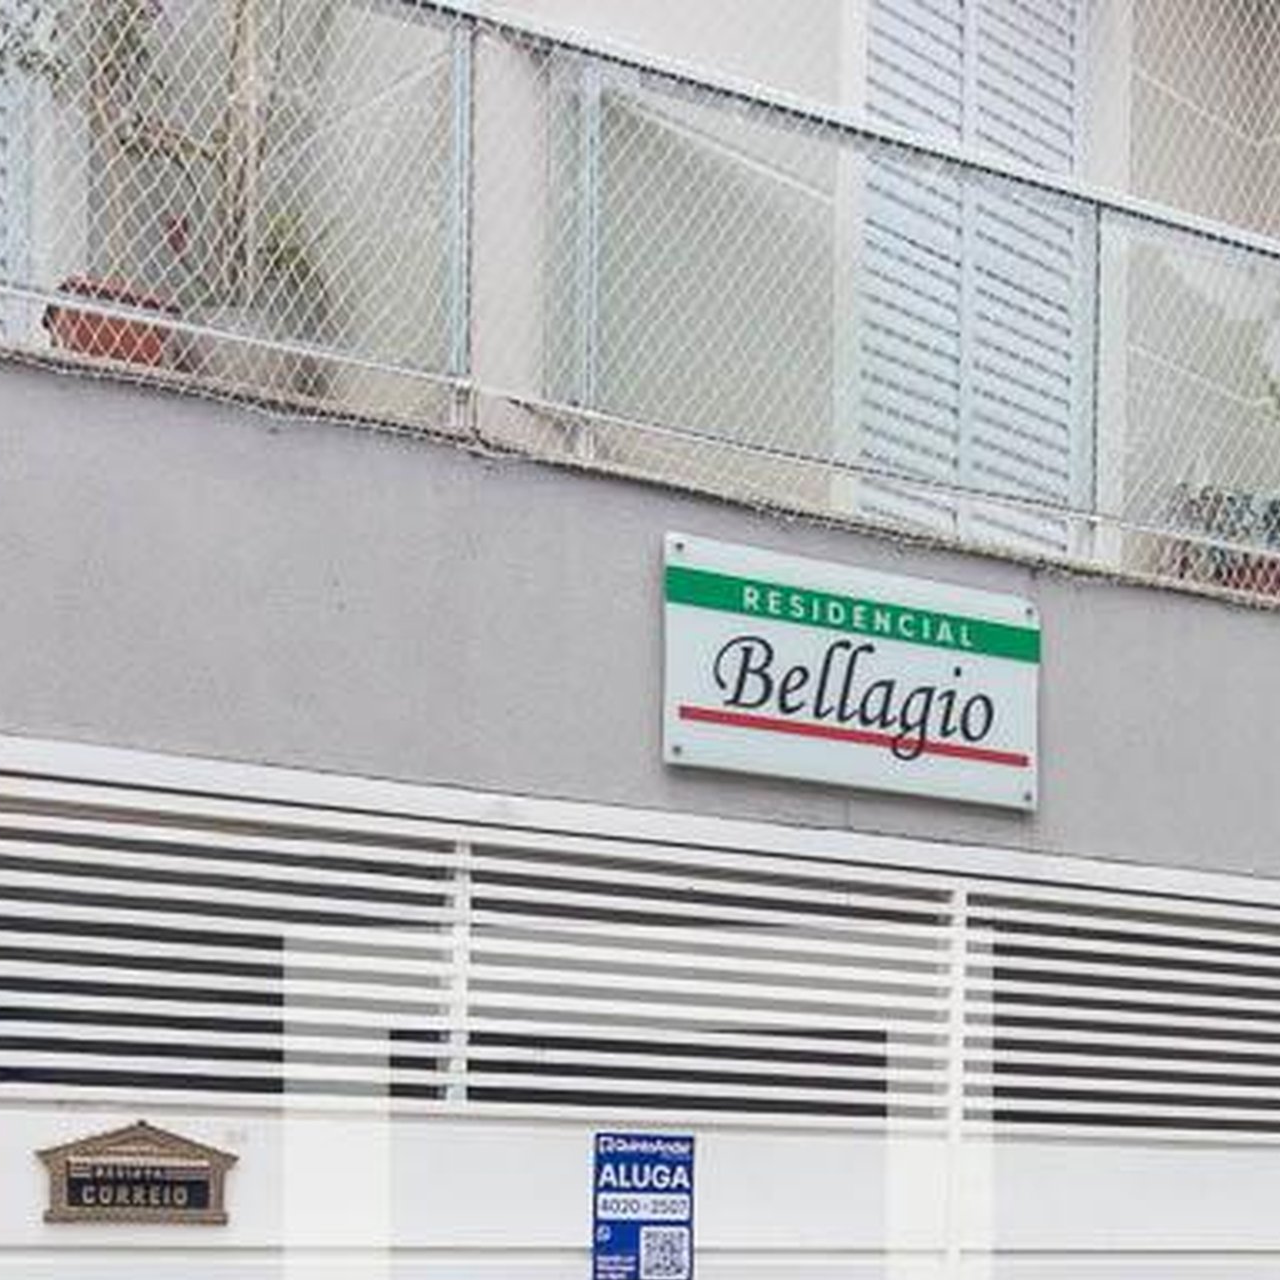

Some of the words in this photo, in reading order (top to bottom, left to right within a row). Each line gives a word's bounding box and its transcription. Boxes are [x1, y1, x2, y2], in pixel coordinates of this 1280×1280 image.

[742, 585, 974, 648] RESIDENCIAL
[713, 635, 995, 761] Bellagio
[81, 1184, 189, 1206] CORREIO
[598, 1163, 691, 1189] ALUGA
